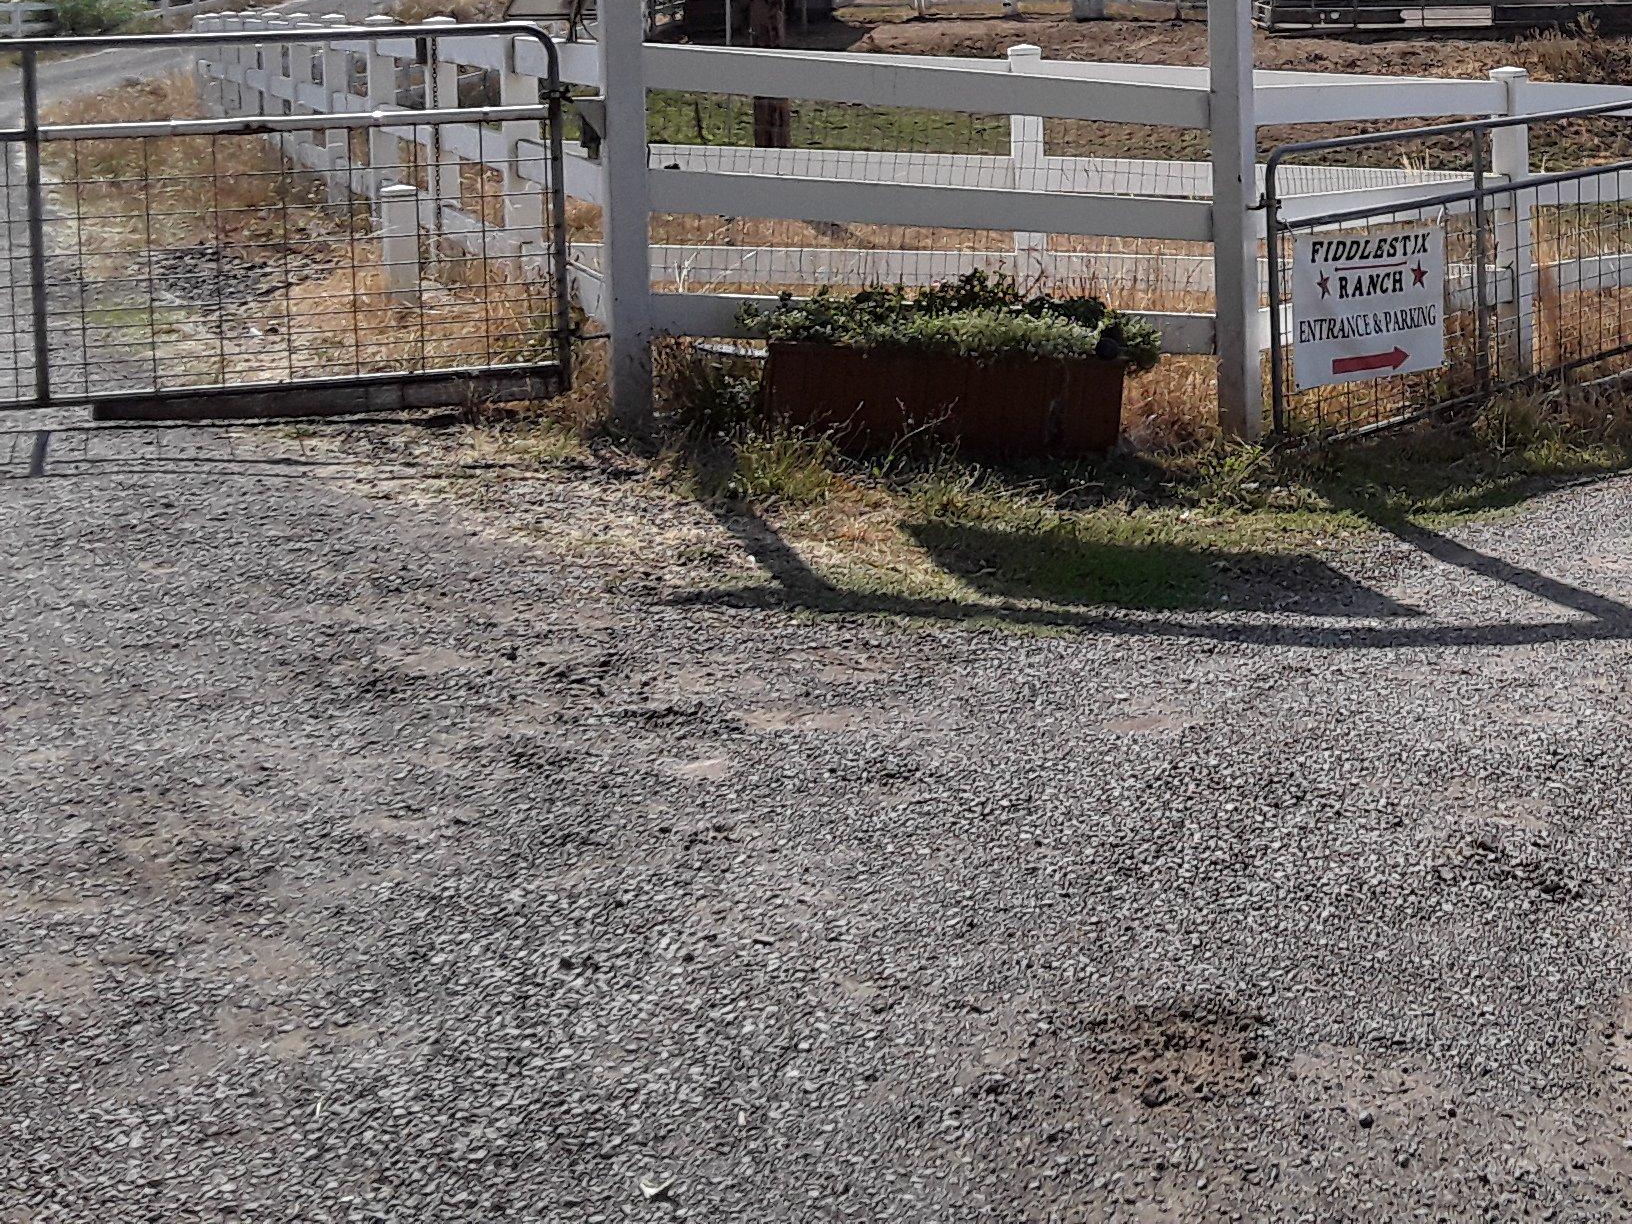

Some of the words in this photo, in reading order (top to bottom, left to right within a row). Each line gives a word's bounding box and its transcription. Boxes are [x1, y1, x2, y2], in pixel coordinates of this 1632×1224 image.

[1311, 232, 1430, 263] FIDDLESTIX
[1338, 270, 1404, 299] RANCH
[1299, 314, 1372, 343] ENTRANCE
[1373, 313, 1383, 335] &
[1383, 304, 1436, 333] PARKING
